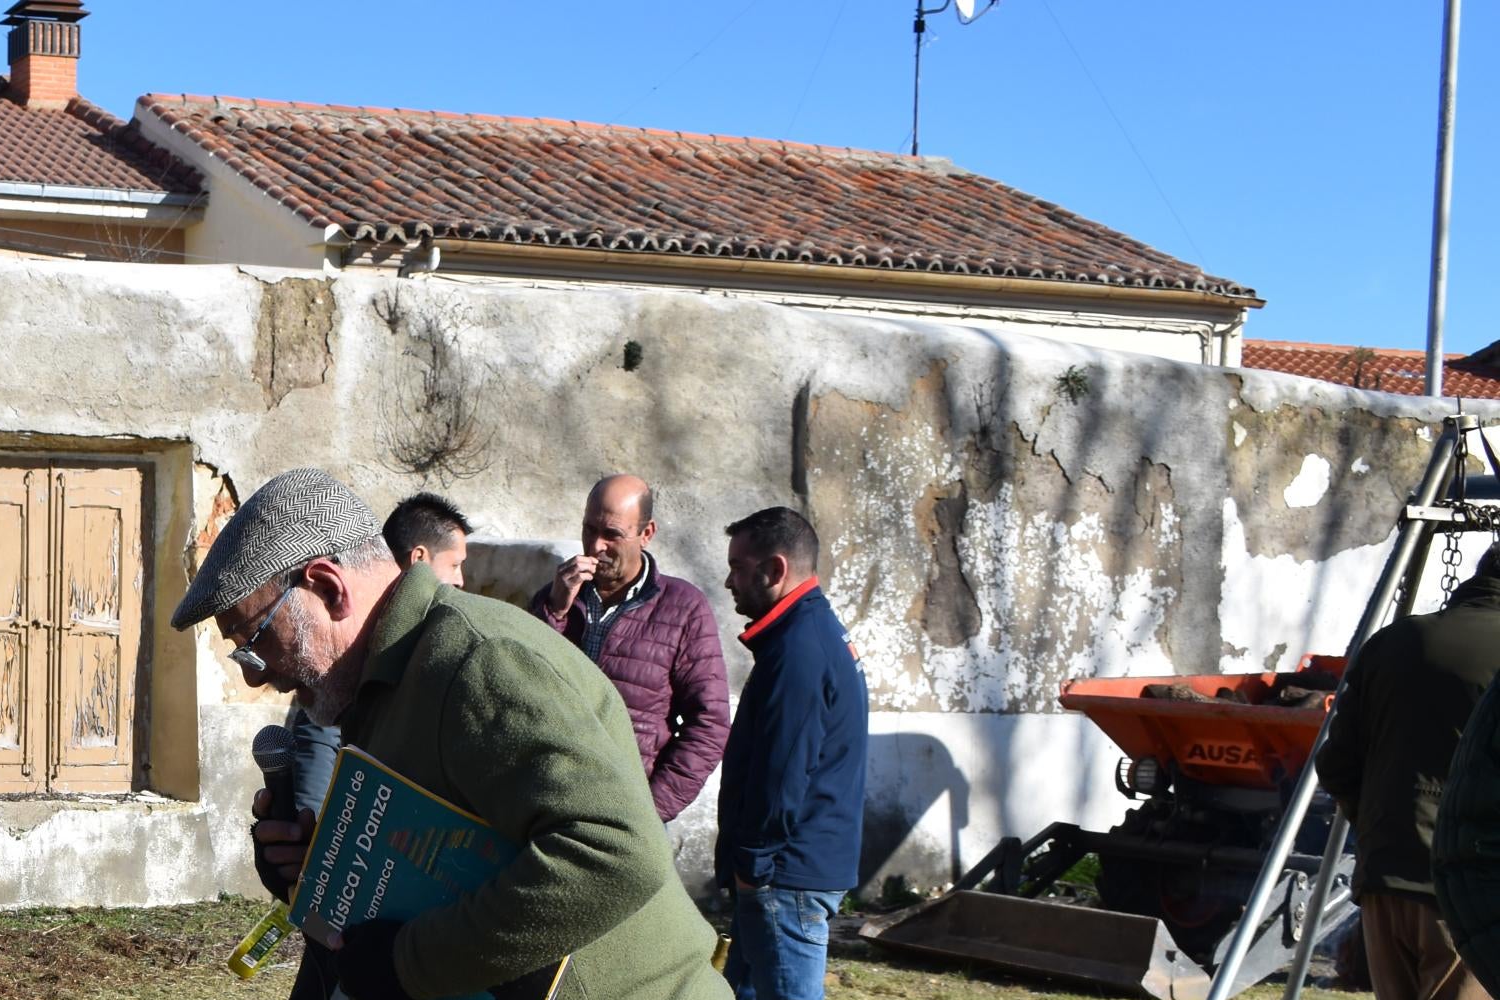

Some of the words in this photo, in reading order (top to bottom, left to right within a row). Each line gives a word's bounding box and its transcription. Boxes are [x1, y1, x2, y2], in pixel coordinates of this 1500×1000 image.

[1187, 743, 1258, 764] AUSA
[321, 792, 357, 871] Municipal
[350, 769, 366, 792] de
[355, 783, 393, 853] Danza
[352, 852, 369, 871] y
